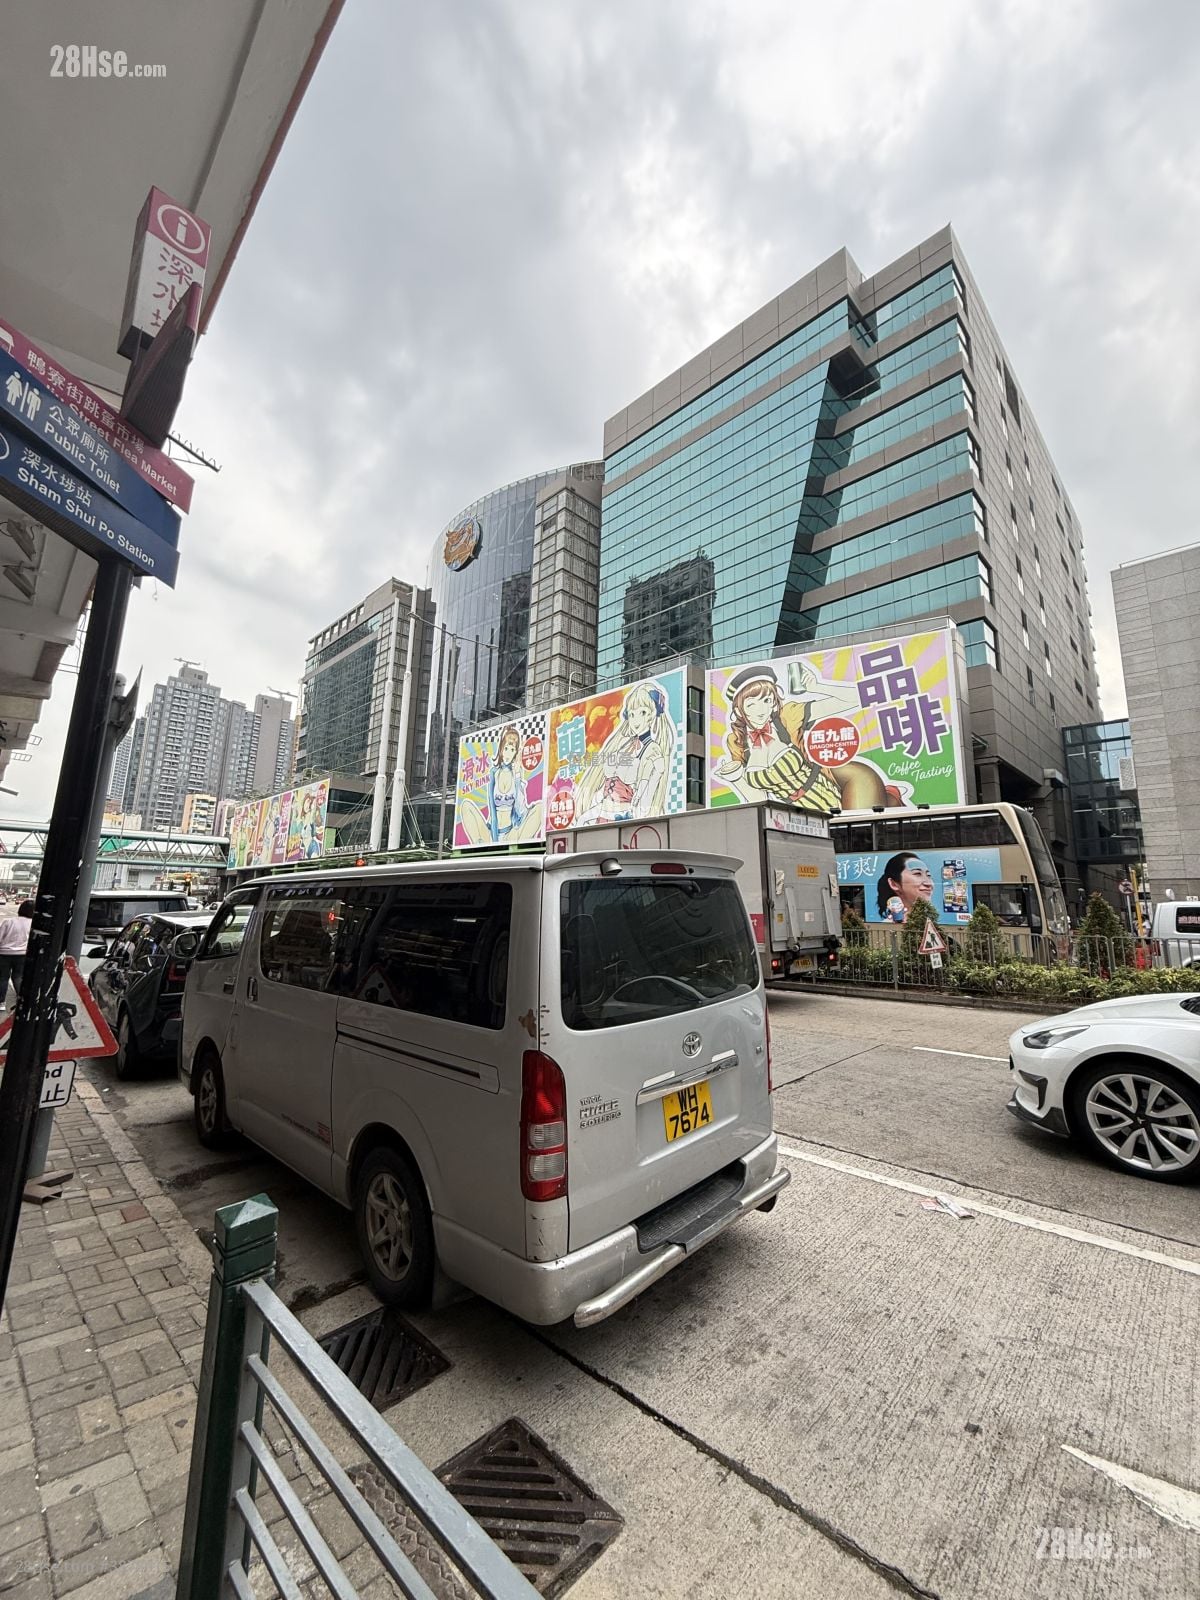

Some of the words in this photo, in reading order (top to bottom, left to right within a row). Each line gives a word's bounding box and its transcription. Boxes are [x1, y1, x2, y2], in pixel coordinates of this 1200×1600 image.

[44, 421, 86, 464] Public
[90, 459, 121, 494] Toilet
[113, 437, 138, 465] Flea
[141, 460, 177, 496] Market
[21, 447, 93, 508] 深水埗站
[17, 467, 61, 504] Sham
[65, 499, 96, 527] Shui
[99, 521, 115, 539] Po
[117, 535, 155, 568] Station
[857, 645, 949, 758] 品啡
[557, 716, 586, 760] 萌
[811, 727, 855, 744] 西九龍
[462, 751, 490, 782] 滑冰
[819, 747, 848, 762] 中心
[888, 760, 921, 776] Coffee
[462, 782, 473, 795] SKY
[911, 764, 954, 783] Tasting
[677, 1084, 698, 1112] WH
[669, 1101, 710, 1138] 7674
